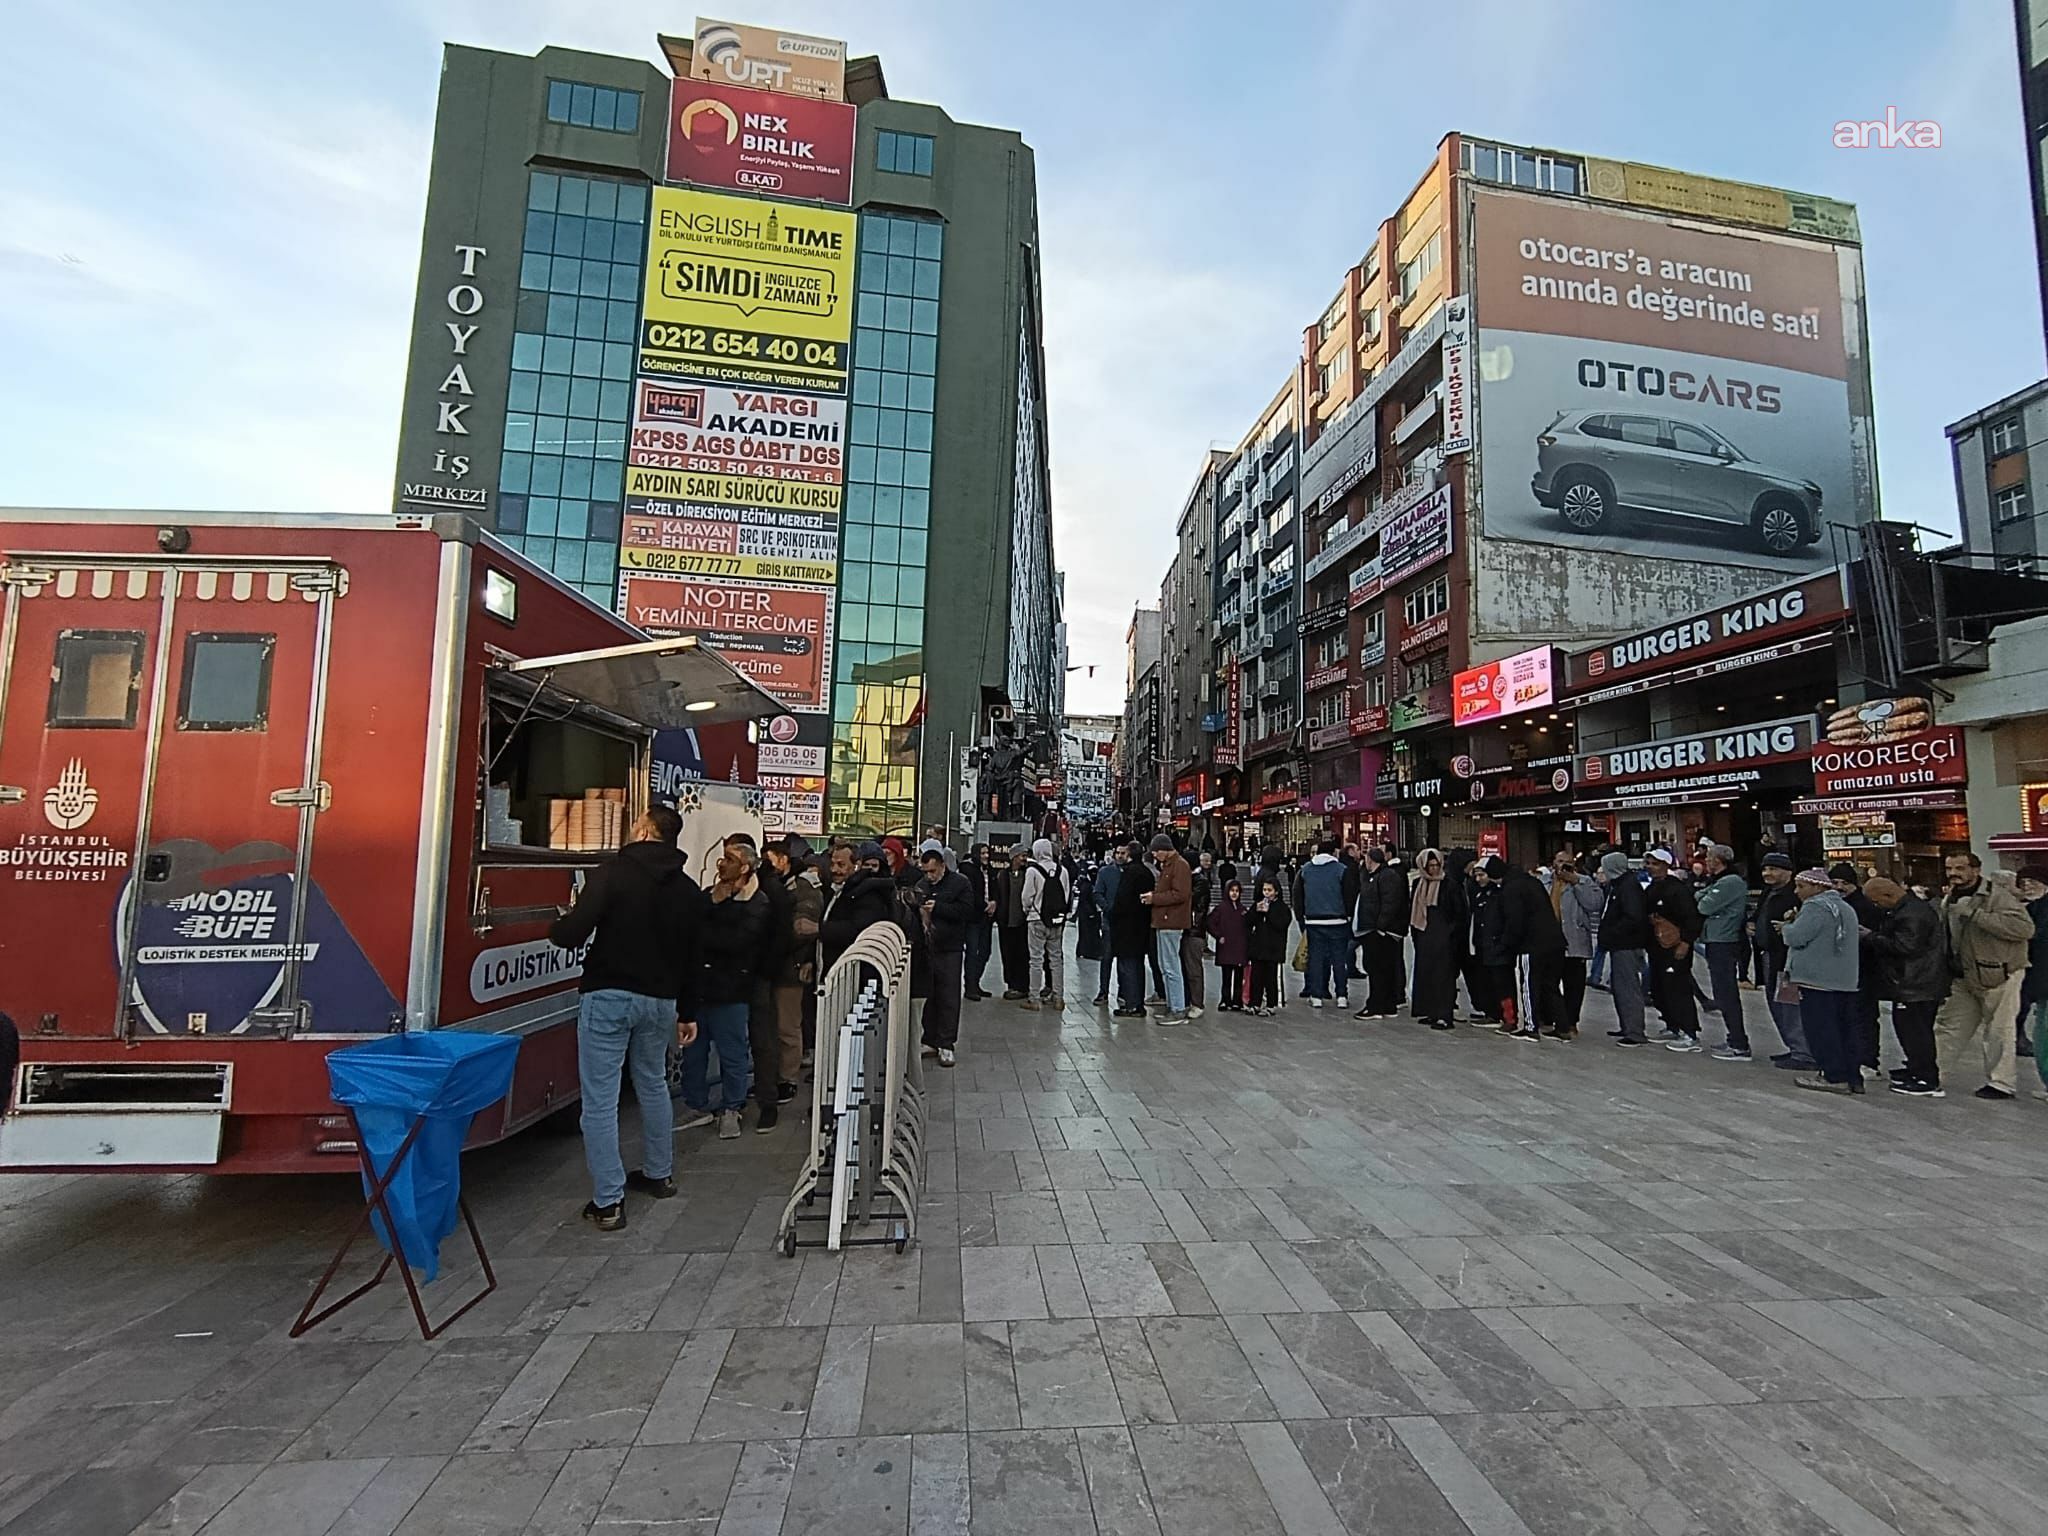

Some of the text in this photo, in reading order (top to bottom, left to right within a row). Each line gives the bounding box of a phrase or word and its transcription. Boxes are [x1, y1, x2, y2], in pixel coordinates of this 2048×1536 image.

[725, 58, 792, 88] UPT
[744, 112, 789, 134] NEX
[740, 173, 778, 187] 8.KAT
[659, 209, 842, 250] ENGLISH TIME
[674, 231, 702, 242] OKULU
[703, 235, 714, 243] VE
[1658, 255, 1753, 293] aracını
[764, 286, 820, 307] ZAMANI
[1521, 270, 1819, 341] anında değerinde sat!
[435, 244, 487, 436] TOYAK
[648, 324, 836, 366] 0212 654 40 04
[706, 367, 720, 378] EN
[721, 369, 741, 381] ÇOK
[742, 370, 773, 384] DEĞER
[774, 374, 805, 387] VEREN
[805, 377, 840, 391] KURUM
[1577, 358, 1781, 414] OTOCARS
[732, 392, 818, 418] YARGI
[707, 414, 839, 442] AKADEMİ
[633, 428, 841, 466] KPSS AGS ÖABT DGS
[637, 452, 683, 469] 0212
[687, 457, 721, 473] 503
[725, 461, 749, 476] 50
[753, 464, 775, 478] 43
[779, 468, 809, 481] KAT
[824, 472, 834, 483] 6
[633, 473, 839, 509] AYDIN SARI SÜRÜCÜ KURSU
[646, 499, 823, 529] ÖZEL DİREKSİYON EĞİTİM MERKEZİ
[662, 521, 733, 539] KARAVAN
[740, 528, 759, 544] SRC
[761, 530, 774, 545] VE
[646, 553, 741, 574] 0212 677 77 77
[783, 566, 826, 580] KATTAYIZ
[683, 586, 772, 612] NOTER
[634, 605, 819, 634] YEMİNLİ TERCÜME
[1612, 590, 1804, 669] BURGER KING
[646, 626, 743, 642] Translation Traduction
[732, 659, 783, 675] rcüme
[1715, 649, 1778, 672] BURGER KING
[1615, 685, 1633, 696] KING
[783, 747, 798, 758] 06
[802, 748, 818, 759] 06
[1609, 726, 1795, 776] BURGER KING
[1811, 733, 1956, 774] KOKOREÇÇİ
[1415, 779, 1442, 798] COFFY
[1678, 774, 1717, 788] ALEVDE
[1718, 770, 1761, 784] IZGARA
[1827, 769, 1935, 791] ramazan usta
[1651, 796, 1671, 805] KING
[1858, 801, 1899, 809] ramazan
[1903, 797, 1924, 806] usta
[19, 833, 110, 847] İSTANBUL
[0, 847, 129, 868] BÜYÜKŞEHİR
[14, 868, 107, 882] BELEDİYESİ
[199, 946, 247, 960] DESTEK
[483, 938, 562, 991] LOJİSTİK
